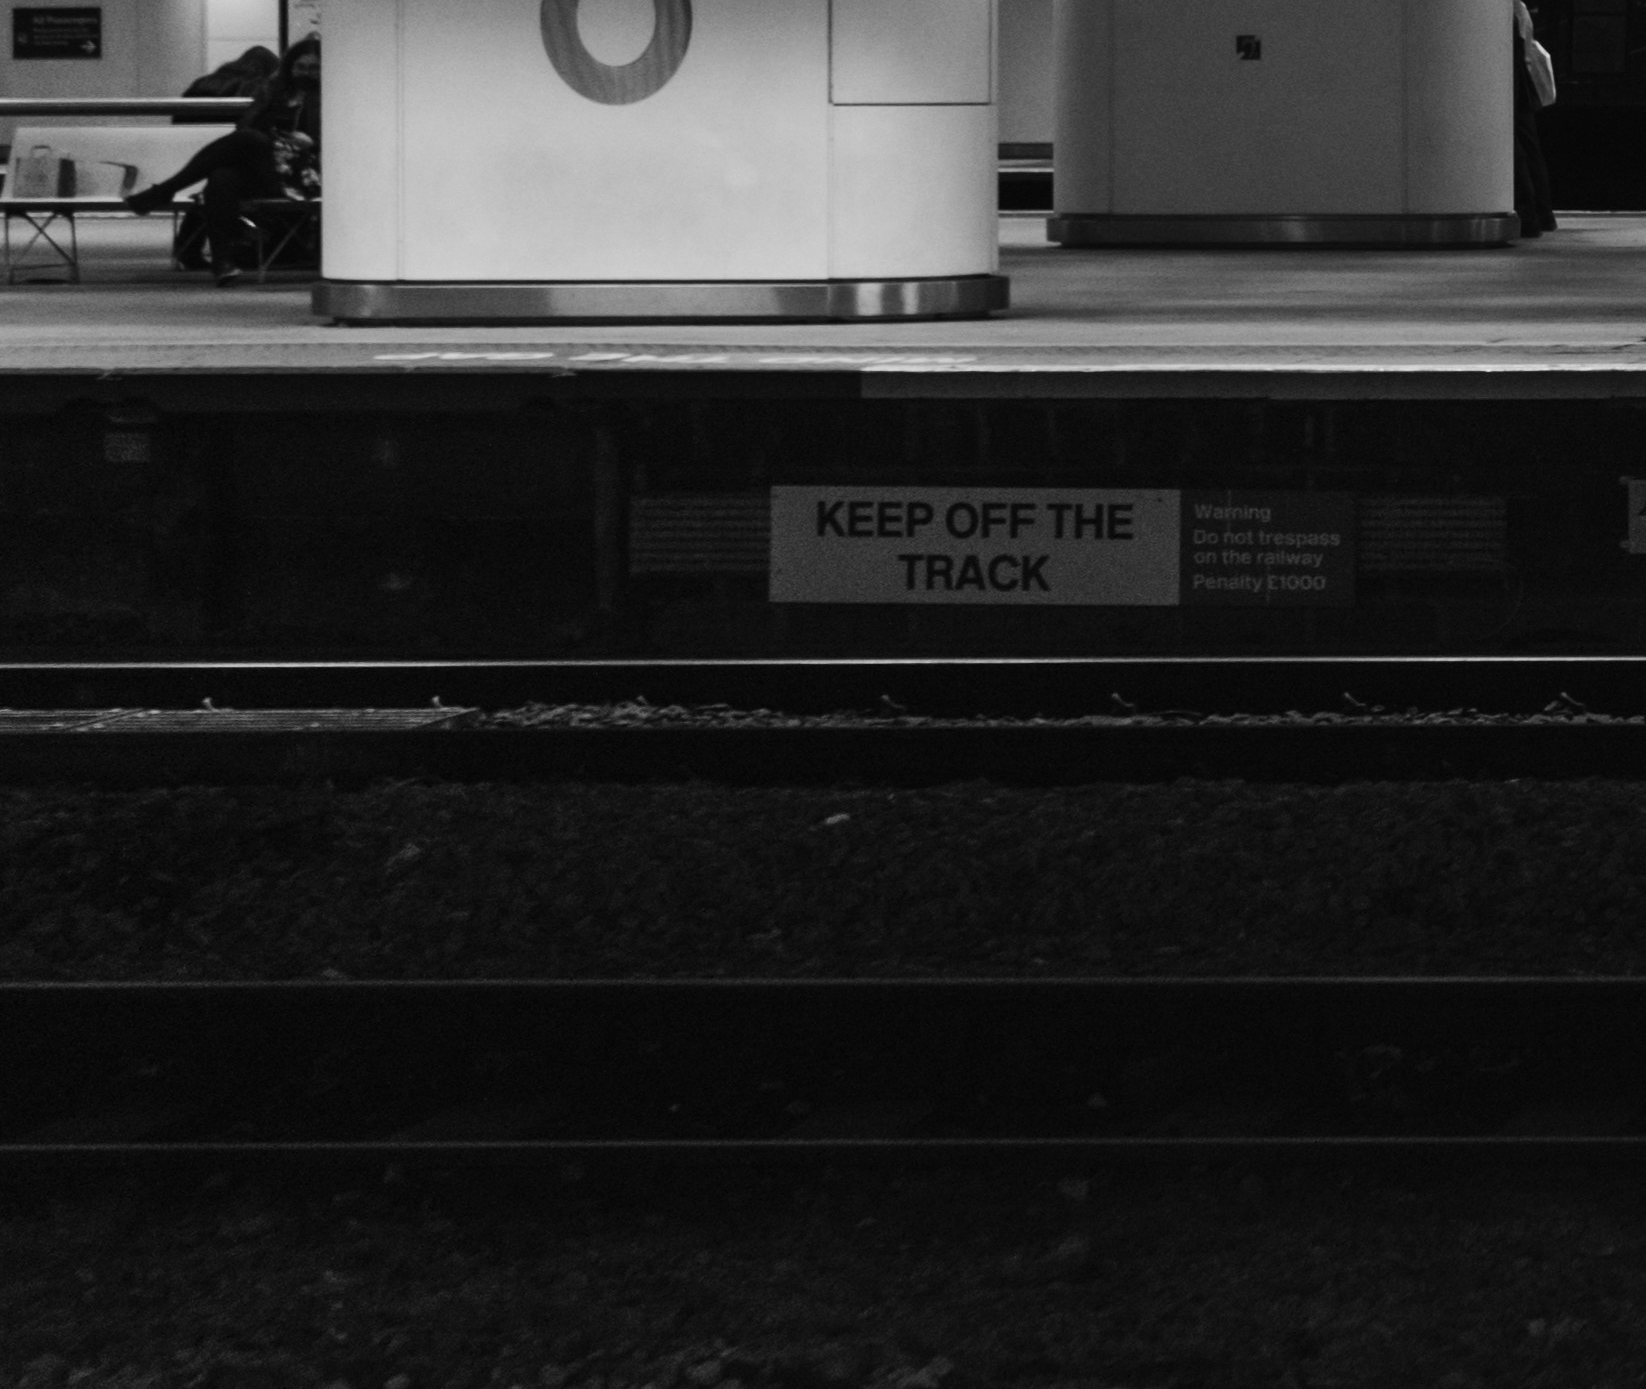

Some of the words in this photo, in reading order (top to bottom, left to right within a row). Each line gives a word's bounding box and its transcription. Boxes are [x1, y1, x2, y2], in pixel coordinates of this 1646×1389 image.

[816, 500, 934, 537] KEEP
[945, 502, 1036, 539] OFF
[1046, 503, 1134, 540] THE
[1194, 504, 1271, 523] Warning
[1193, 529, 1219, 544] Do
[1223, 530, 1253, 545] not
[1259, 530, 1341, 548] trespass
[1193, 551, 1217, 564] on
[1222, 549, 1251, 564] the
[1256, 550, 1324, 568] railway
[898, 554, 1050, 591] TRACK
[1193, 574, 1262, 593] Penalty
[1267, 574, 1327, 591] £1000
